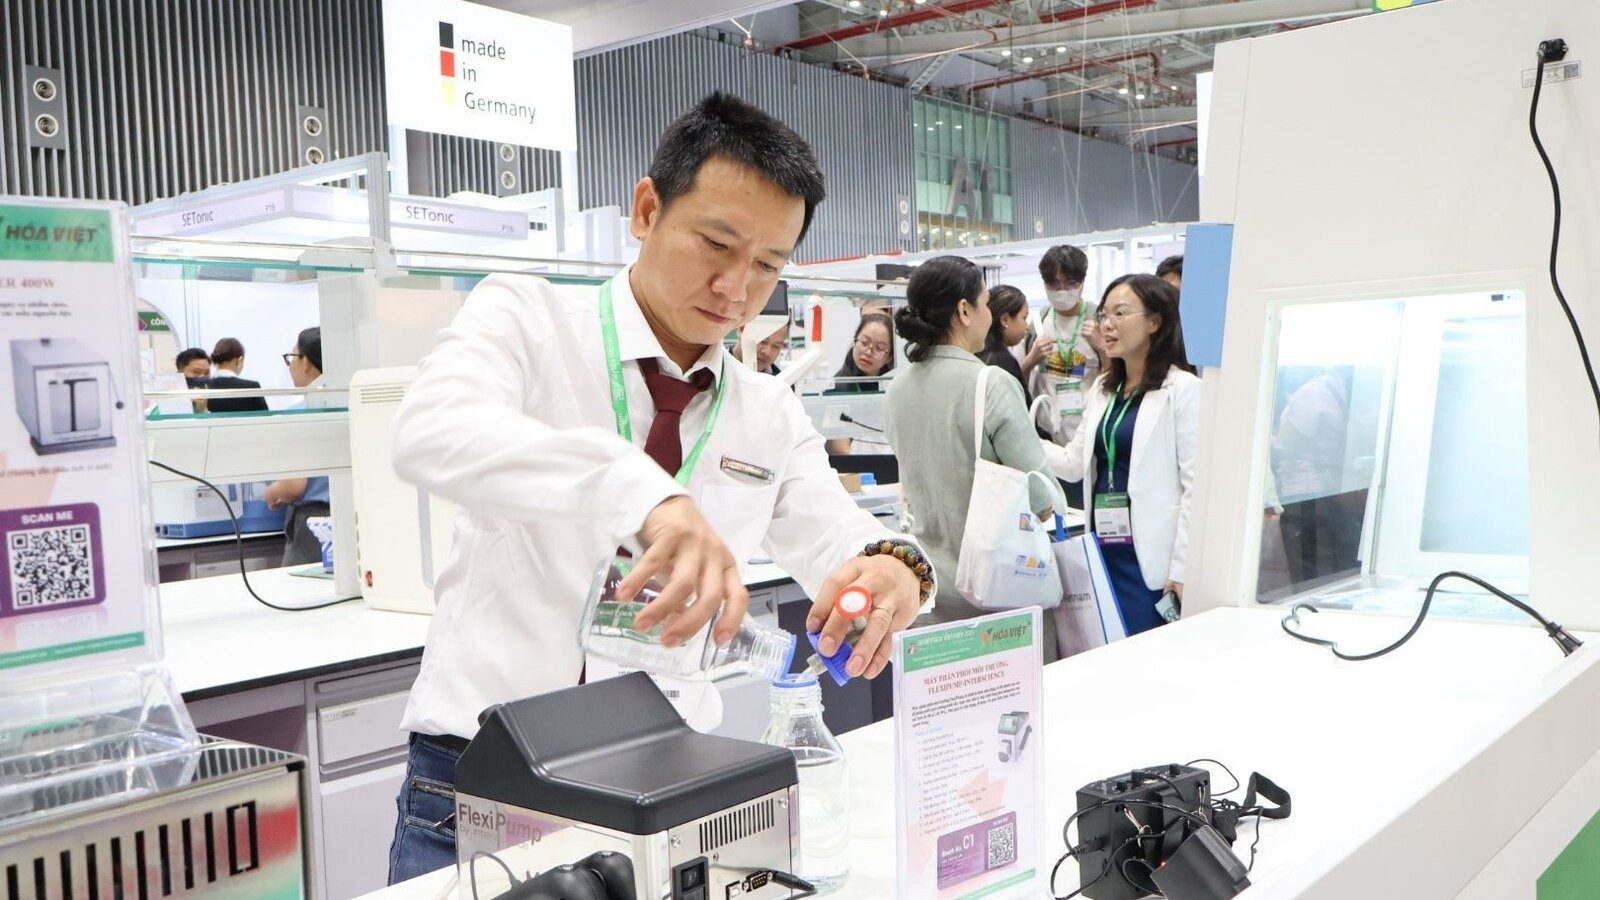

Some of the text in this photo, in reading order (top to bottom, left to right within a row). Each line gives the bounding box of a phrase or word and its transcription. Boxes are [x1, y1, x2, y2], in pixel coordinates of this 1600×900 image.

[461, 38, 506, 60] made
[462, 62, 477, 82] in
[464, 91, 536, 125] Germany
[21, 510, 74, 525] SCAN ME
[963, 833, 975, 850] C1
